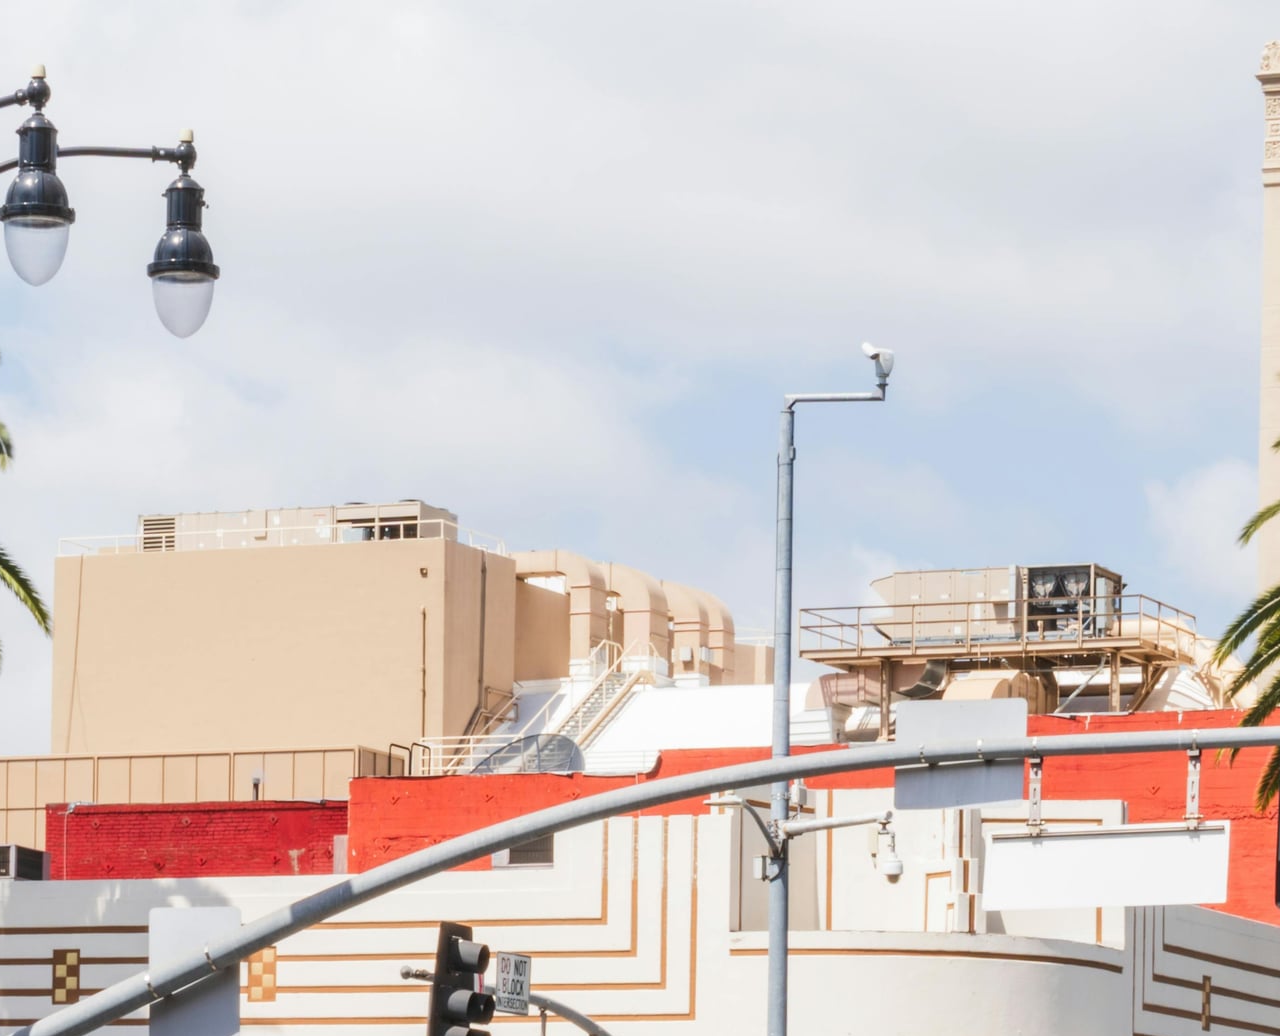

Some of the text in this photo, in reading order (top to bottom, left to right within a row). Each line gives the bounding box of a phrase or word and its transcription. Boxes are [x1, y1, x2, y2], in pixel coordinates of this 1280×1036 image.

[501, 957, 528, 977] DO NOT
[502, 979, 525, 995] BLOCK
[497, 996, 529, 1011] INTERSECTION
